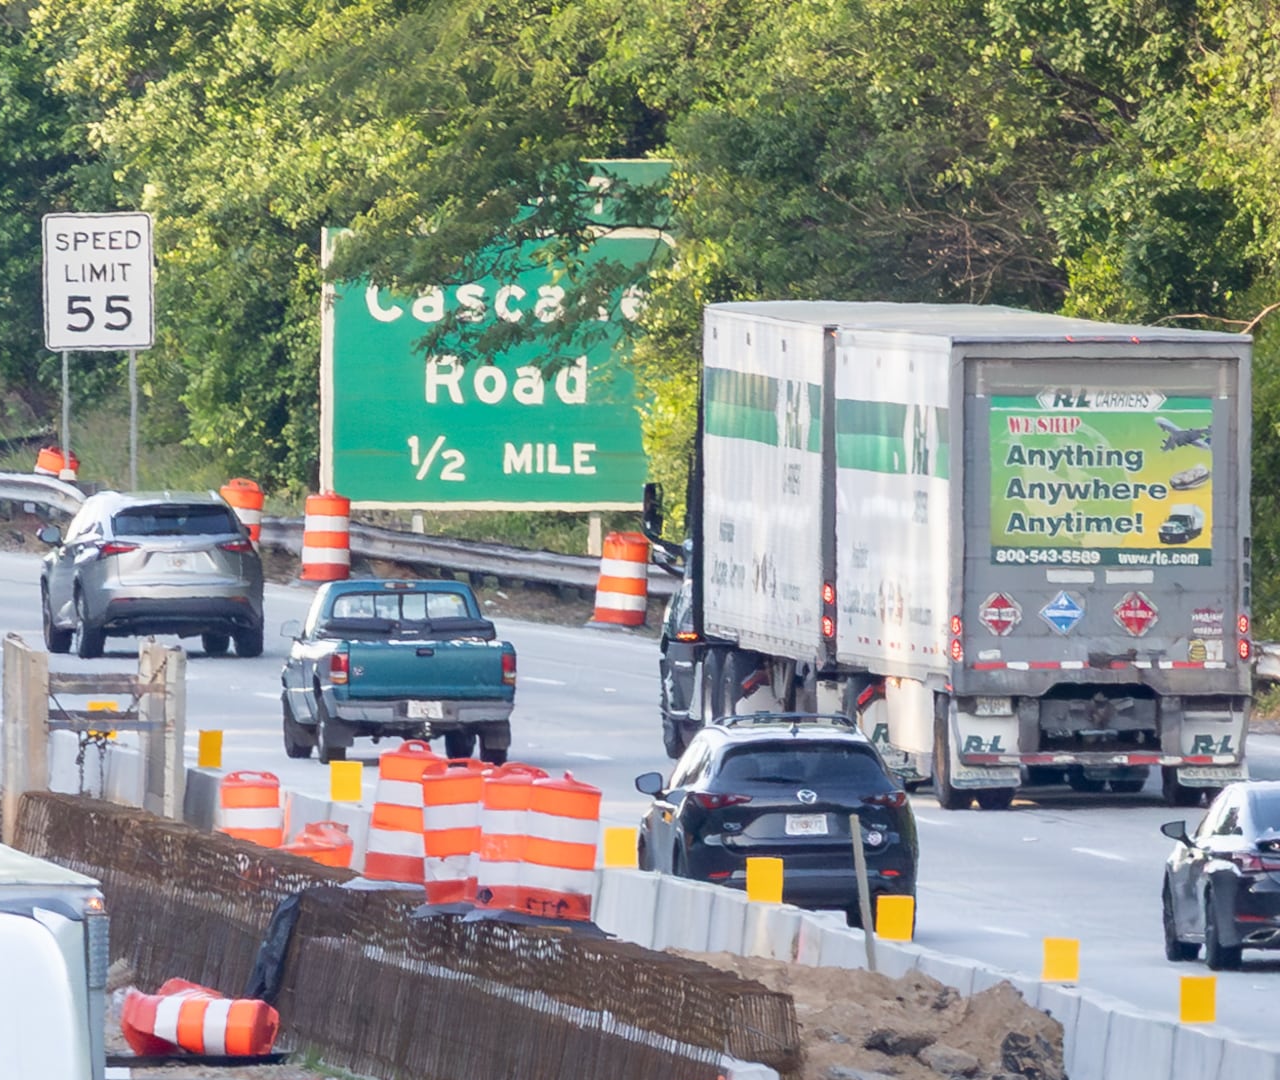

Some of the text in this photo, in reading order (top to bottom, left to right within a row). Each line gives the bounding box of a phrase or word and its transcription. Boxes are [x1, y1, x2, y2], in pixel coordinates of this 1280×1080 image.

[56, 230, 142, 251] SPEED
[65, 262, 132, 282] LIMIT
[66, 294, 132, 332] 55
[365, 281, 647, 323] Cascae
[425, 354, 588, 404] Road
[1095, 389, 1149, 408] CARRIERS
[1008, 417, 1080, 433] WE SHIP
[503, 442, 597, 474] MILE
[1006, 445, 1143, 471] Anything
[1006, 478, 1167, 505] Anywhere
[1006, 512, 1143, 536] Anytime!
[996, 549, 1199, 565] 800-543-5589 www.rlc.com
[963, 735, 1006, 752] R+L
